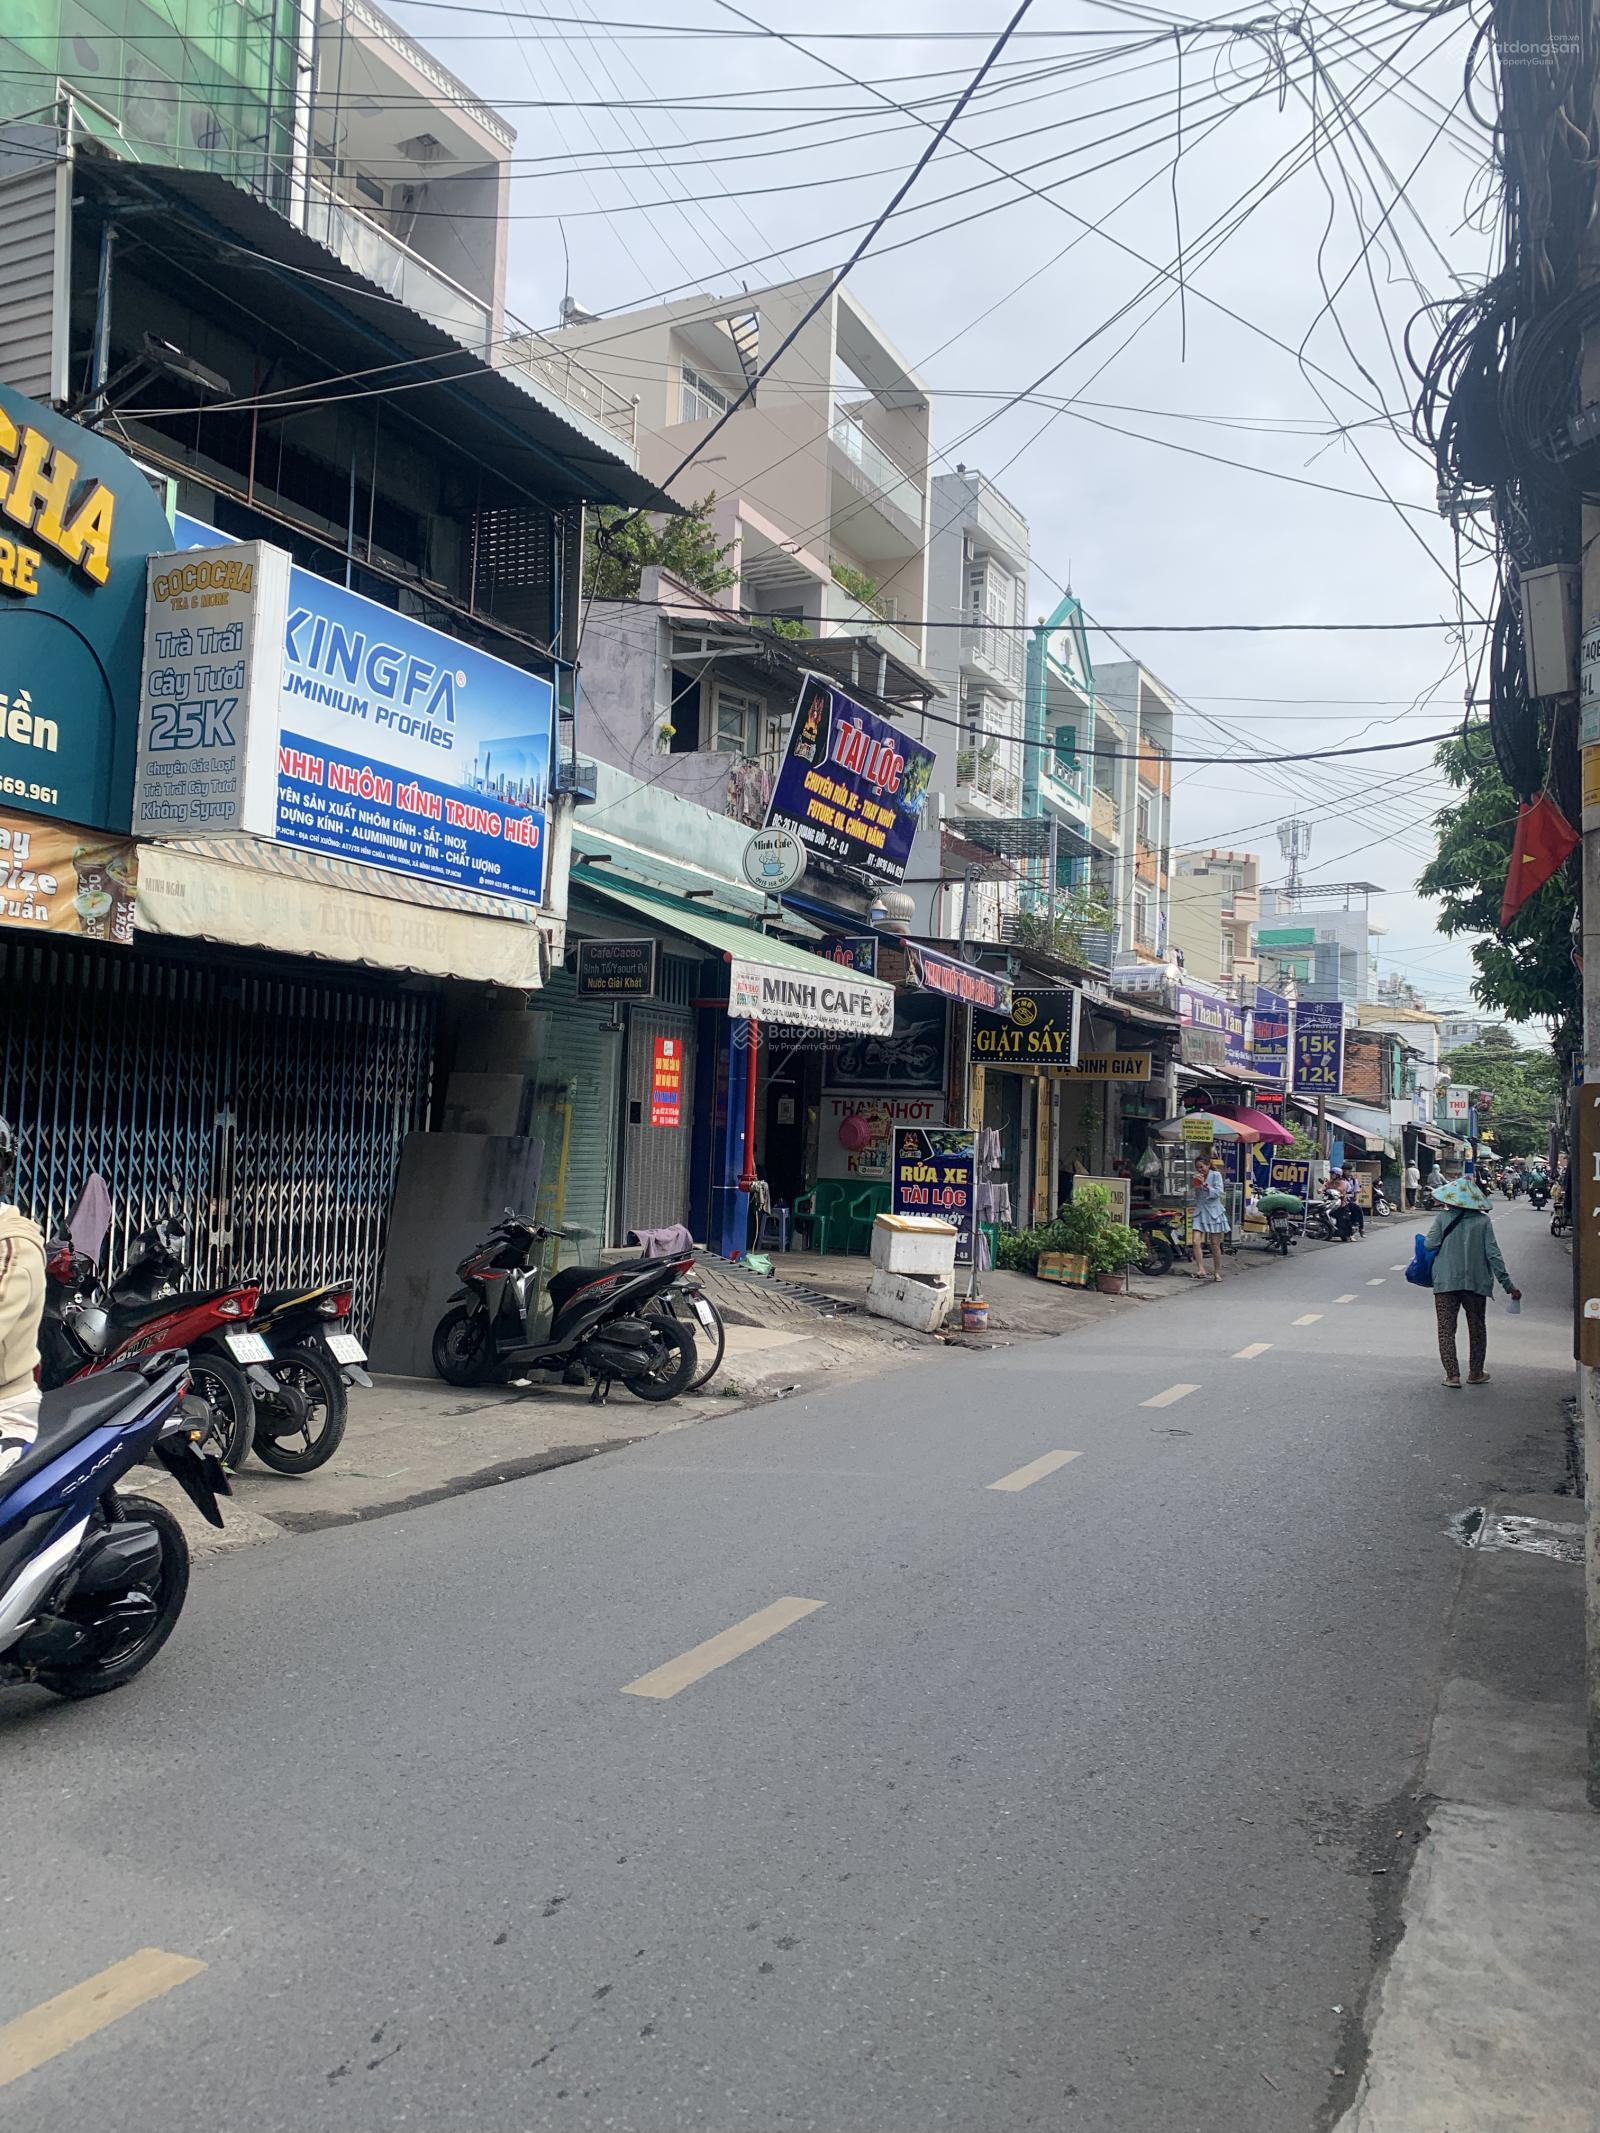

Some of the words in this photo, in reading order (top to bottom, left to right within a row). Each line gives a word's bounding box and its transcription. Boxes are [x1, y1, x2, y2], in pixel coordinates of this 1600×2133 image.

[152, 560, 253, 602] COCOCHA
[155, 629, 193, 659] Trà
[197, 622, 244, 653] Trái
[148, 666, 191, 700] Cây
[194, 661, 246, 694] Tươi
[148, 698, 239, 752] 25K
[146, 757, 187, 778] Chuyên
[211, 756, 236, 775] Loại
[831, 716, 871, 774] TÀI
[862, 737, 905, 796] LỘC
[0, 777, 59, 806] 69.961
[140, 803, 188, 822] Không
[190, 800, 236, 821] Syrup
[328, 765, 392, 806] NHÔM
[398, 780, 441, 819] KÍNH
[445, 798, 501, 839] TRUNG
[503, 813, 540, 849] HIẾU
[302, 791, 326, 812] SẢN
[328, 801, 357, 821] XUẤT
[360, 809, 391, 830] NHÔM
[393, 819, 417, 837] KÍNH
[444, 834, 467, 851] INOX
[280, 806, 315, 827] DỰNG
[316, 815, 344, 834] KÍNH
[352, 826, 408, 852] ALUMINIUM
[410, 840, 424, 855] UY
[424, 843, 440, 860] TÍN
[445, 850, 471, 868] CHẤT
[471, 857, 502, 875] LƯỢNG
[753, 839, 773, 851] Minh
[145, 877, 165, 893] MINH
[607, 976, 623, 989] Giải
[624, 976, 642, 989] Khát
[762, 977, 817, 1010] MINH
[1193, 997, 1223, 1029] Thanh
[976, 1023, 1024, 1058] GIẶT
[1027, 1019, 1068, 1053] SẤY
[1299, 1035, 1337, 1054] 15k
[1078, 1059, 1107, 1074] SINH
[1298, 1066, 1337, 1084] 12k
[882, 1099, 934, 1121] NHỚT
[900, 1161, 939, 1184] RỬA
[943, 1167, 969, 1185] XE
[1272, 1161, 1308, 1187] GIẶT
[900, 1184, 929, 1205] TÀI
[932, 1186, 968, 1209] LỘC
